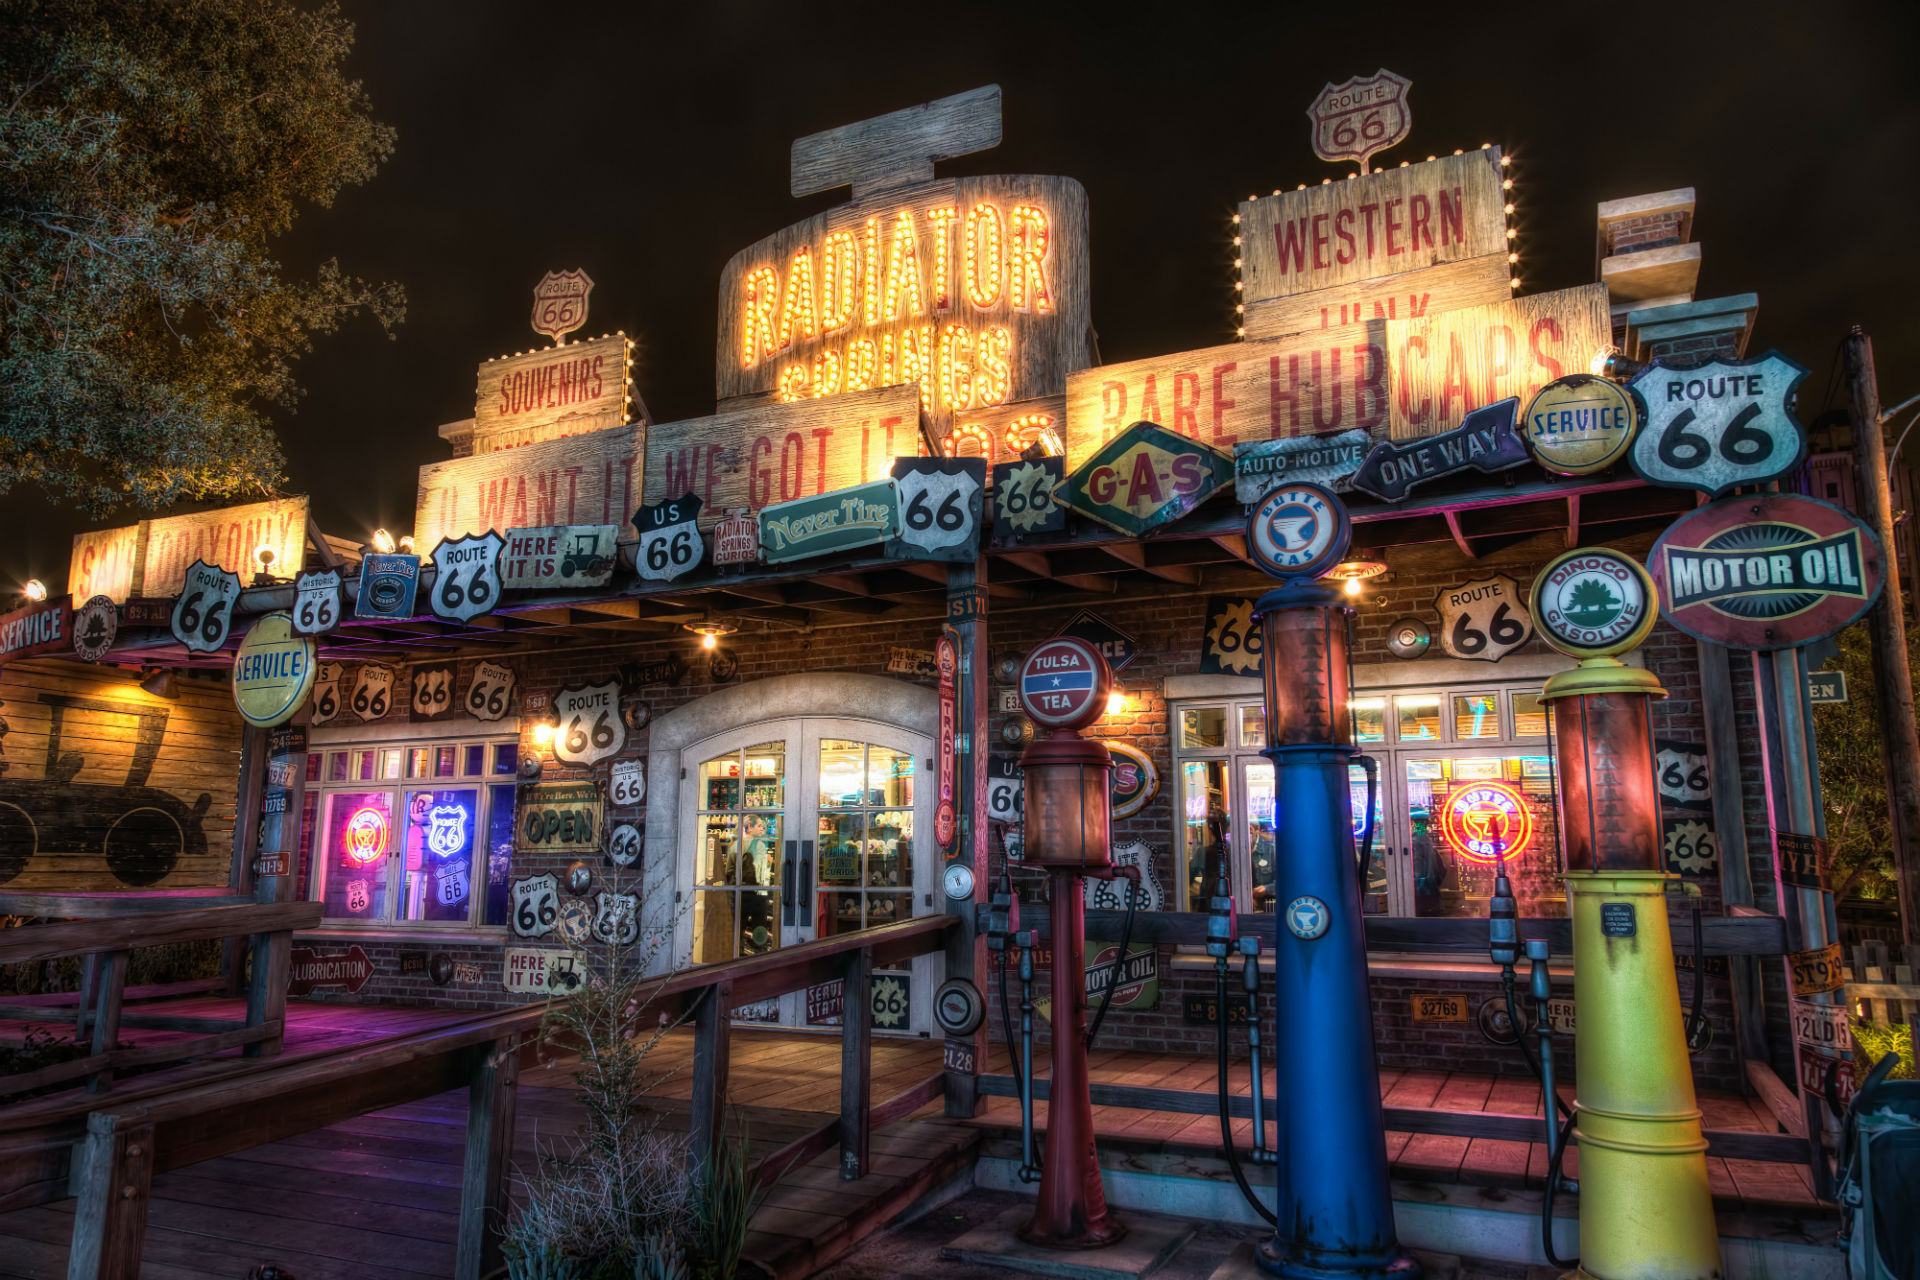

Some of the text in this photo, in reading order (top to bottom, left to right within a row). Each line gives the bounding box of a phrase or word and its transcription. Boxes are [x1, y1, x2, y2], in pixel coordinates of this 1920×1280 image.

[1329, 85, 1385, 110] ROUTE
[1332, 110, 1385, 148] 66
[1273, 186, 1464, 276] WESTERN
[546, 281, 579, 294] ROUTE
[743, 201, 1055, 370] RADIATOR
[542, 300, 574, 324] 66
[499, 355, 604, 417] SOUVENIRS
[1666, 374, 1764, 402] ROUTE
[1101, 359, 1239, 448] RARE
[1534, 405, 1626, 436] SERVICE
[1657, 401, 1775, 470] 66
[1242, 445, 1362, 475] AUTO-MOTIVE
[1379, 447, 1435, 486] ONE
[1438, 425, 1499, 466] WAY
[477, 465, 584, 536] WANT
[603, 455, 638, 529] IT
[665, 443, 726, 517] WE
[749, 427, 835, 512] GOT
[860, 415, 903, 485] IT
[1088, 451, 1203, 515] G-A-S
[1007, 476, 1050, 514] 66
[1261, 491, 1328, 518] BUTTE
[653, 504, 680, 526] US
[905, 487, 965, 531] 66
[715, 521, 756, 539] RADIATOR
[767, 496, 890, 550] Never Tire
[446, 545, 488, 565] ROUTE
[511, 536, 558, 556] HERE
[646, 531, 693, 571] 66
[715, 549, 755, 562] CURIOS
[721, 535, 752, 552] SPRINGS
[508, 558, 555, 579] IT IS
[1273, 549, 1314, 566] GAS
[1670, 541, 1858, 600] MOTOR OIL
[197, 571, 233, 594] ROUTE
[303, 575, 335, 589] HISTORIC
[441, 563, 490, 609] 66
[1550, 557, 1630, 588] DINOCO
[81, 597, 114, 616] DINOCO
[311, 590, 324, 599] US
[1450, 583, 1503, 608] ROUTE
[179, 591, 228, 643] 66
[300, 597, 332, 626] 66
[1547, 603, 1639, 645] GASOLINE
[0, 607, 63, 656] SERVICE
[1218, 617, 1263, 655] 66
[1452, 601, 1525, 655] 66
[236, 650, 302, 683] SERVICE
[481, 667, 509, 682] ROUTE
[1034, 654, 1080, 670] TULSA
[363, 669, 388, 683] ROUTE
[353, 683, 386, 716] 66
[418, 679, 447, 706] 66
[469, 680, 505, 715] 66
[568, 692, 610, 712] ROUTE
[1041, 695, 1072, 710] TEA
[565, 709, 614, 754] 66
[943, 702, 951, 796] TRADING
[614, 763, 641, 773] HISTORIC
[1662, 761, 1710, 792] 66
[614, 779, 641, 801] 66
[434, 826, 459, 849] 66
[525, 808, 594, 845] OPEN
[610, 832, 639, 857] 66
[1674, 832, 1715, 860] 66
[444, 881, 462, 901] 66
[519, 879, 550, 895] ROUTE
[1094, 878, 1152, 910] 66
[350, 896, 366, 909] 66
[517, 892, 557, 931] 66
[597, 909, 632, 938] 66
[294, 958, 367, 981] LUBRICATION
[510, 954, 546, 971] HERE
[1131, 957, 1155, 980] OIL
[509, 971, 544, 986] IT IS
[873, 988, 902, 1014] 66
[1420, 1001, 1459, 1018] 32769
